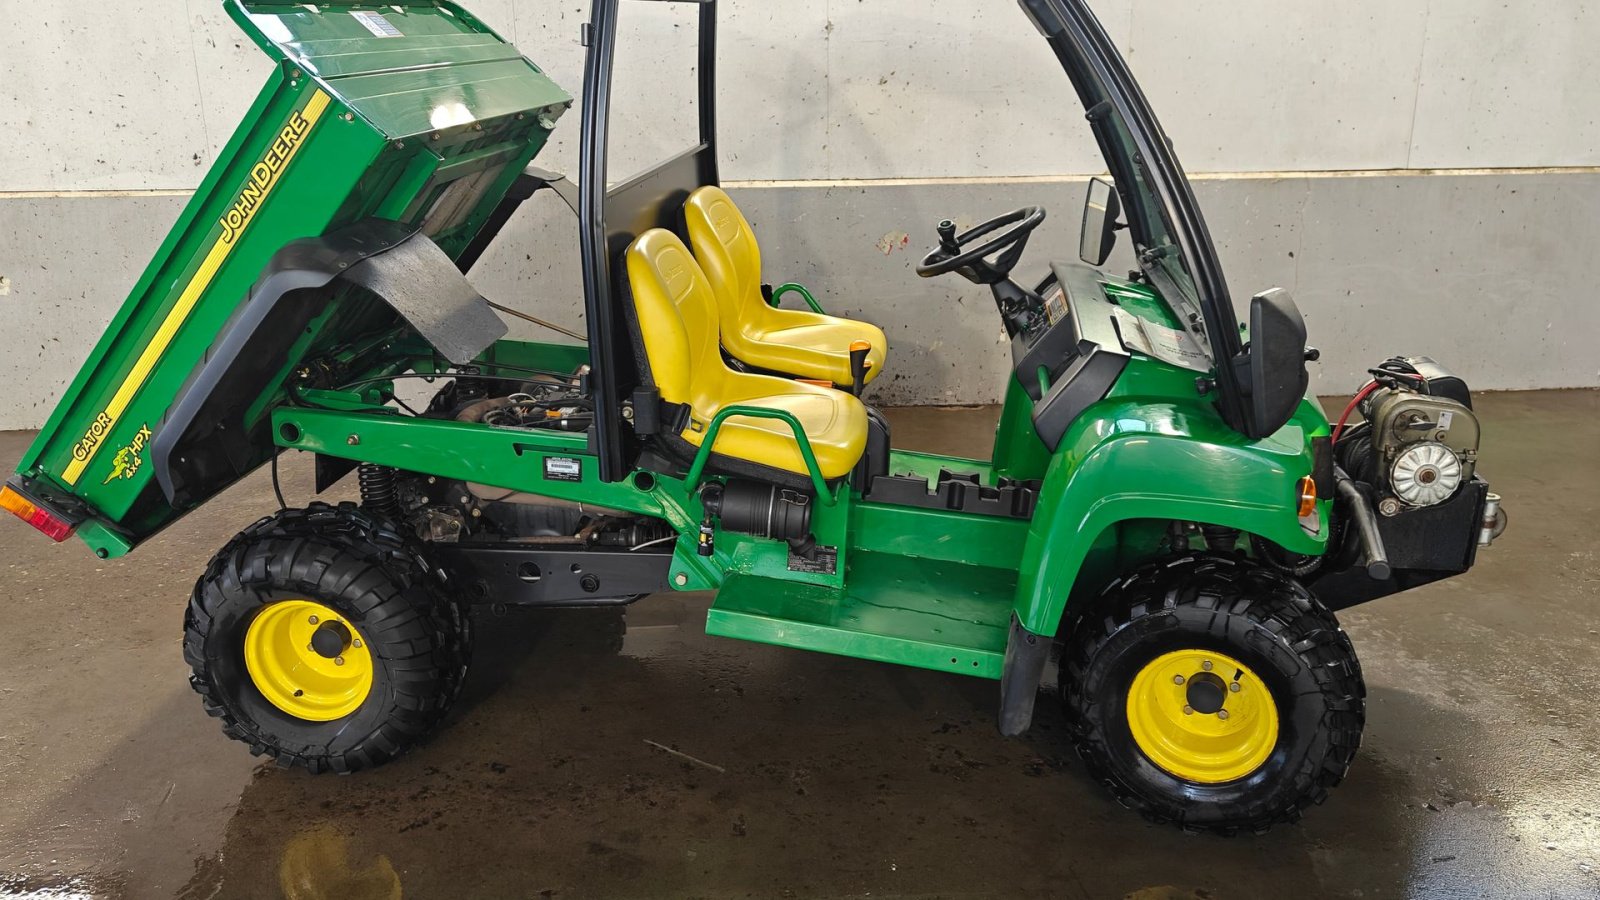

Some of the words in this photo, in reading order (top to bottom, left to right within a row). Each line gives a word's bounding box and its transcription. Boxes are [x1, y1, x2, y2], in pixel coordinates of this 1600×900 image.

[219, 182, 262, 243] JOHN
[250, 110, 309, 190] DEERE
[73, 412, 111, 461] GATOR
[128, 423, 152, 456] HPX
